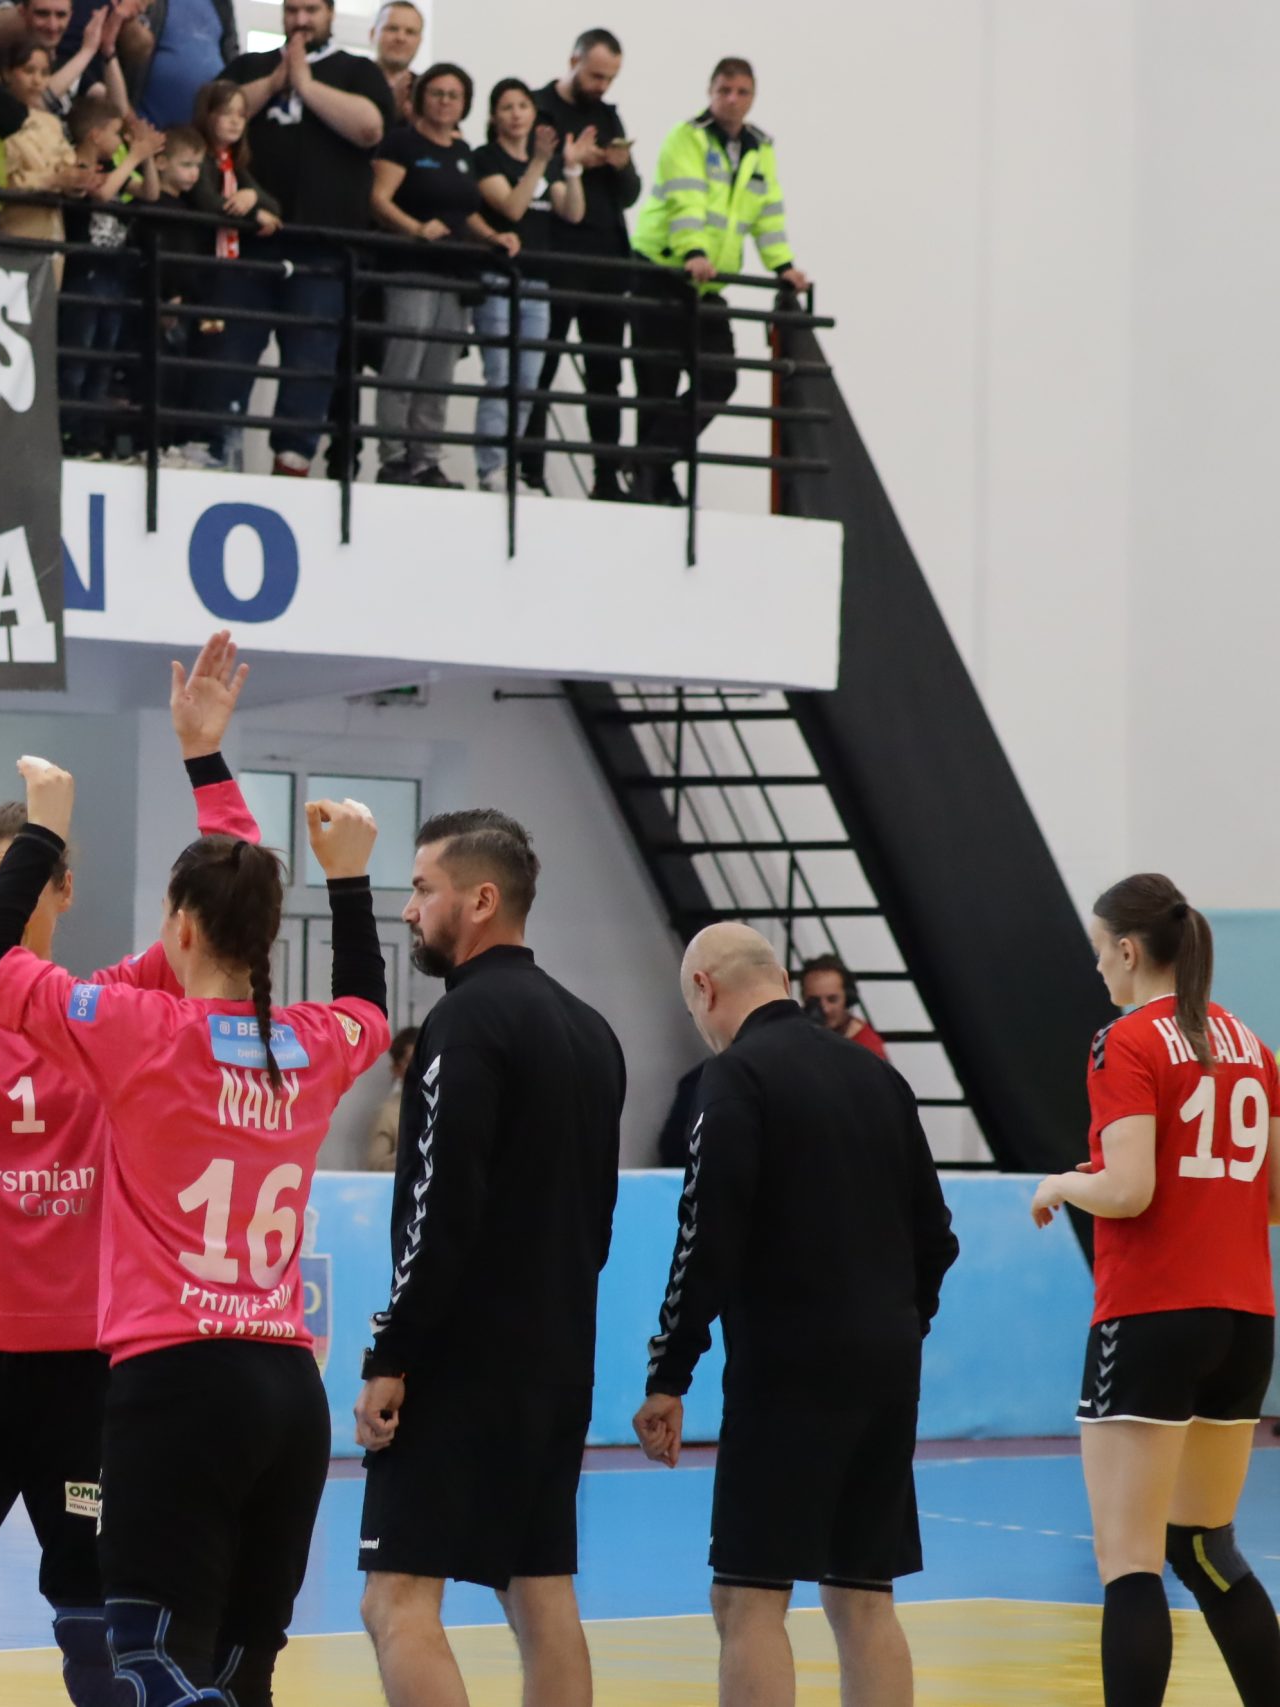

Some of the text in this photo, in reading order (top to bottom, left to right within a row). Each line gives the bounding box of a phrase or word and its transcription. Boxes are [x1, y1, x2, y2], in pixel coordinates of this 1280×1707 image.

[7, 1076, 46, 1134] 1
[1178, 1075, 1269, 1183] 19
[177, 1158, 304, 1290] 16
